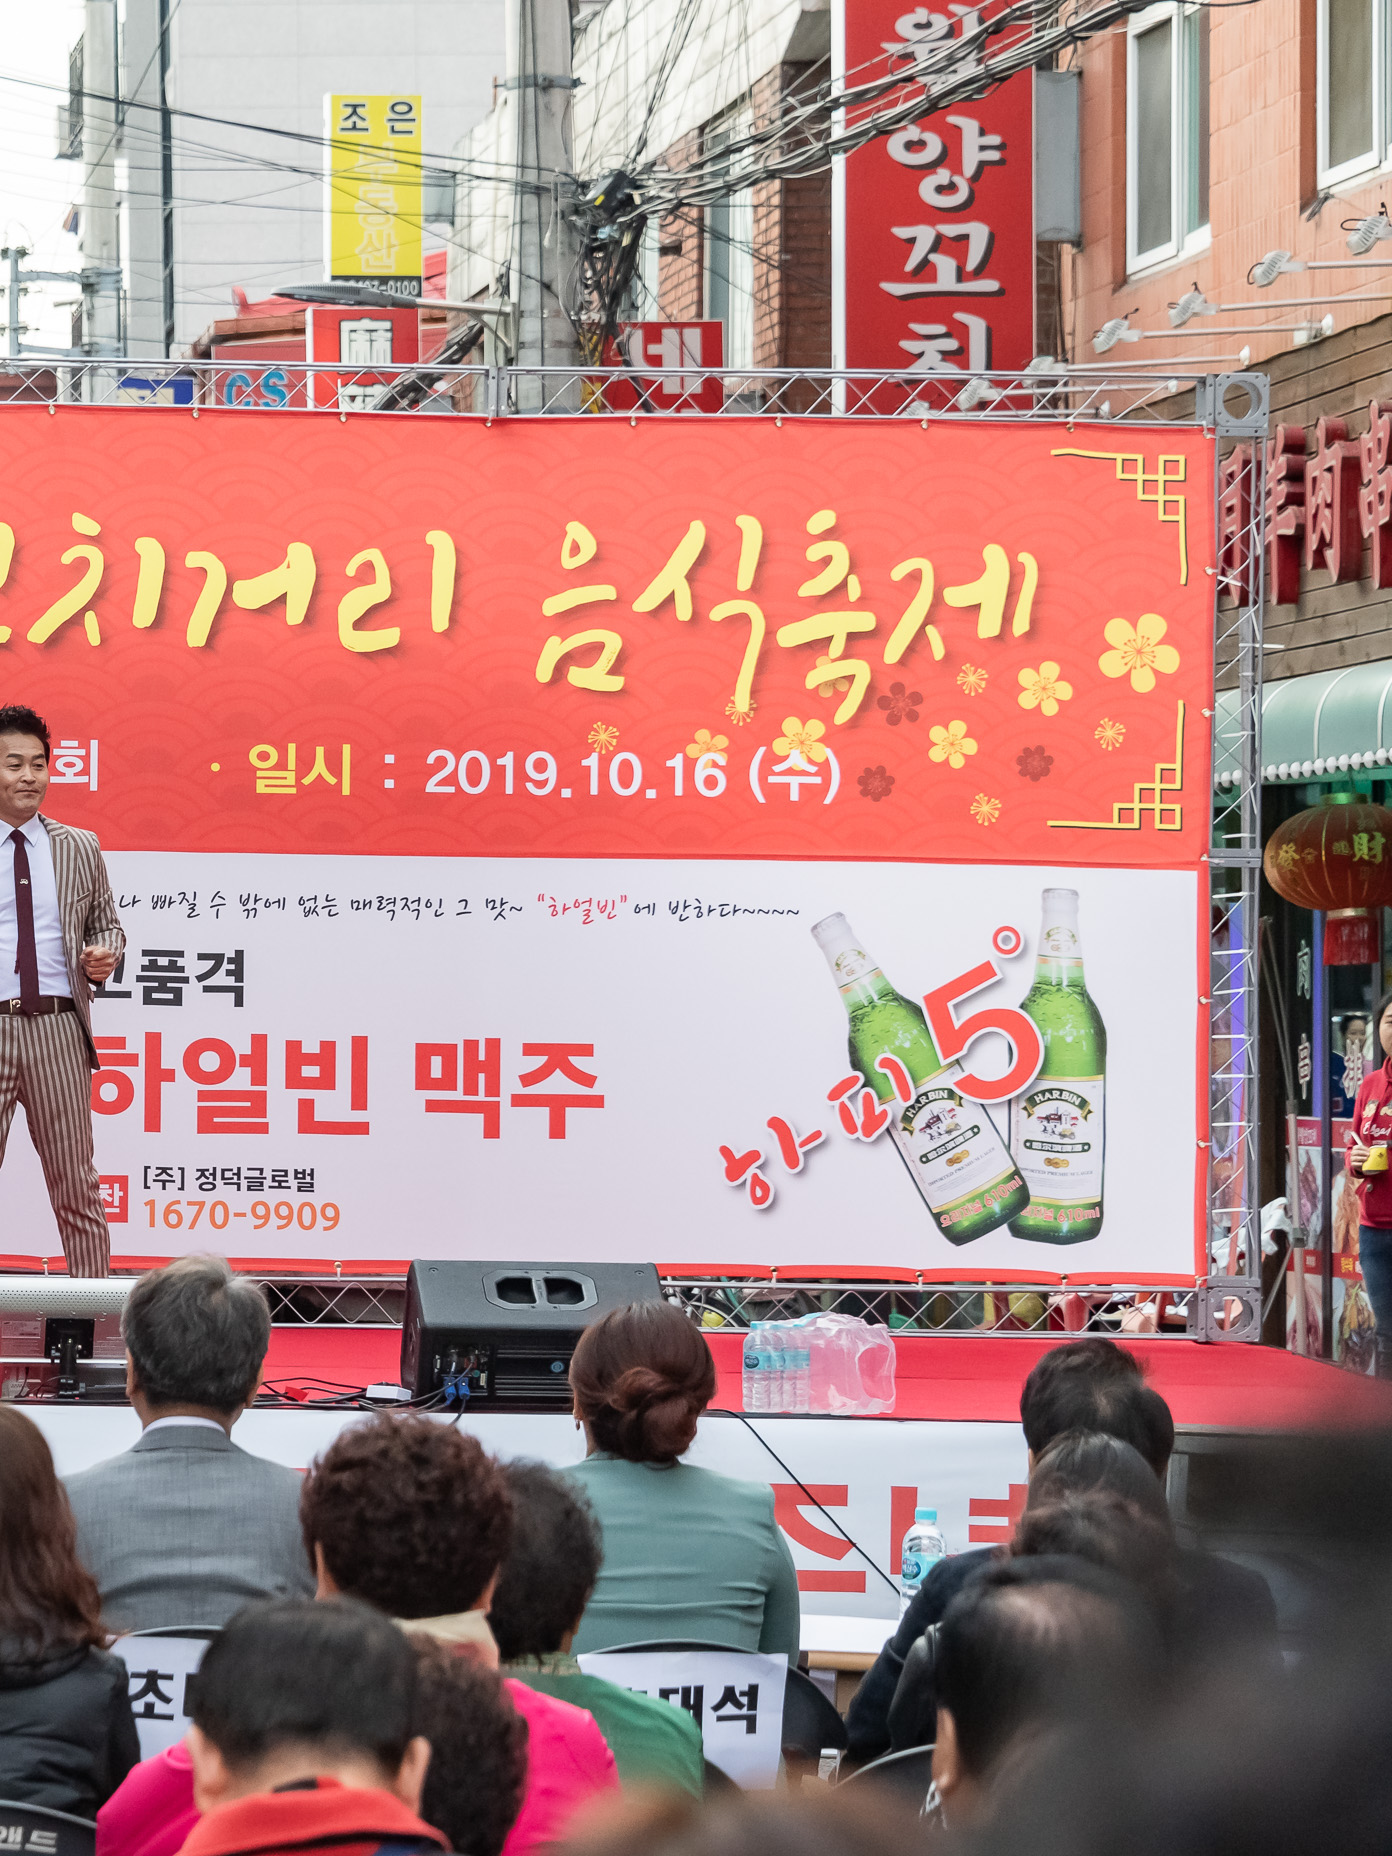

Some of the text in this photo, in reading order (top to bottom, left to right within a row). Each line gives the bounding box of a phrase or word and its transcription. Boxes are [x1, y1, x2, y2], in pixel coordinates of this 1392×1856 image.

[536, 510, 1038, 725] 음식축제
[249, 744, 351, 796] 일시
[425, 748, 728, 799] 2019.10.16
[748, 746, 841, 804] (수)
[151, 891, 200, 919] 빠질
[209, 890, 227, 919] 수
[239, 893, 286, 919] 밖에
[298, 894, 339, 917] 없는
[350, 896, 445, 921] 매력적인
[455, 898, 472, 916] 그
[91, 1032, 605, 1140] 하얼빈 맥주
[1034, 1090, 1082, 1106] HARBIN
[905, 1090, 948, 1118] HARBIN
[143, 1165, 315, 1193] [주] 정덕글로벌
[983, 1175, 1024, 1207] 610ml
[144, 1199, 340, 1232] 1670-9909
[1020, 1205, 1101, 1223] 리지널 610ml
